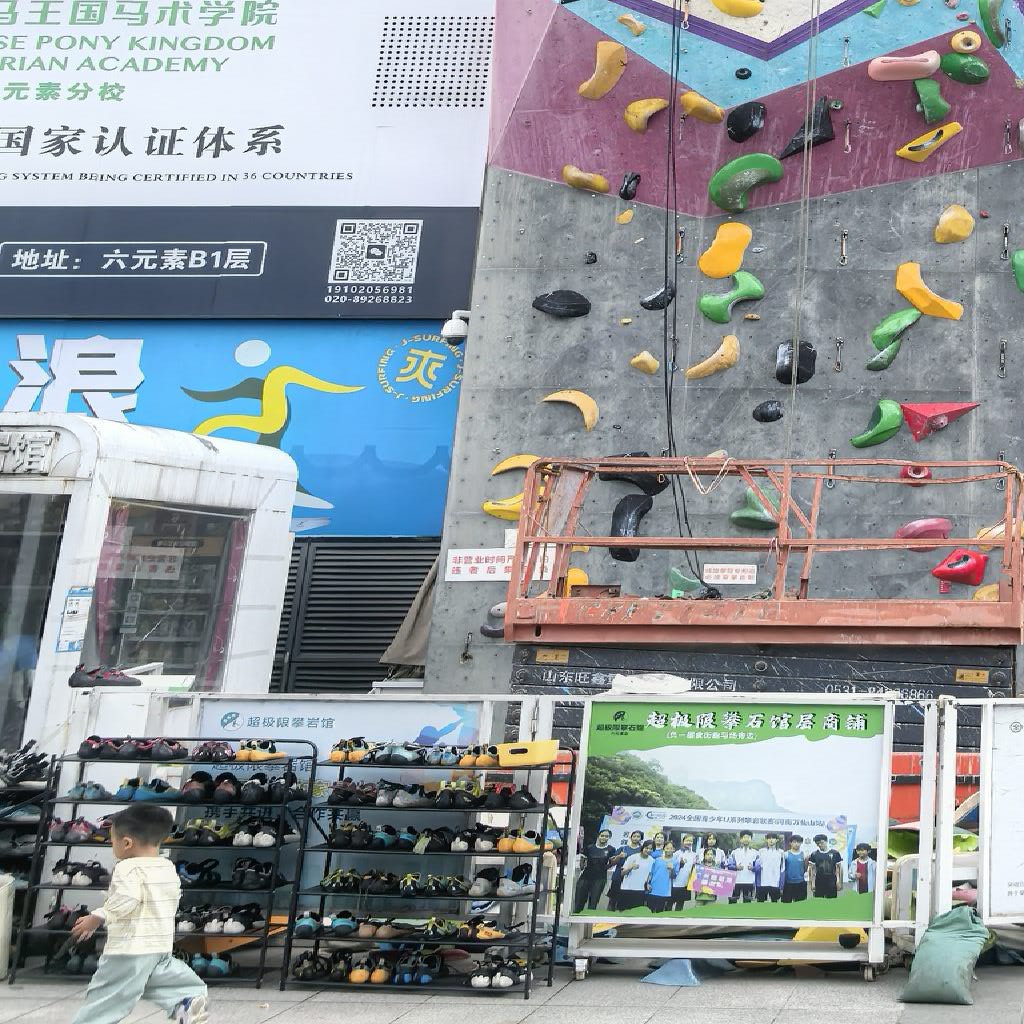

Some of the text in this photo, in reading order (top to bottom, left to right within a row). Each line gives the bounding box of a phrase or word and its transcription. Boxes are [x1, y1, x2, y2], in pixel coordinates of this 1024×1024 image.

[36, 36, 121, 50] PONY
[128, 36, 276, 51] KINGDOM
[76, 57, 230, 72] ACADEMY
[3, 82, 126, 102] 元素分校
[0, 125, 286, 159] 国家认证体系
[12, 173, 74, 181] SYSTEM
[79, 173, 128, 182] BEING
[132, 174, 217, 182] CERTIFIED
[220, 174, 238, 182] IN
[242, 172, 257, 180] 36
[262, 172, 354, 181] COUNTRIES
[327, 285, 413, 294] 19102056981
